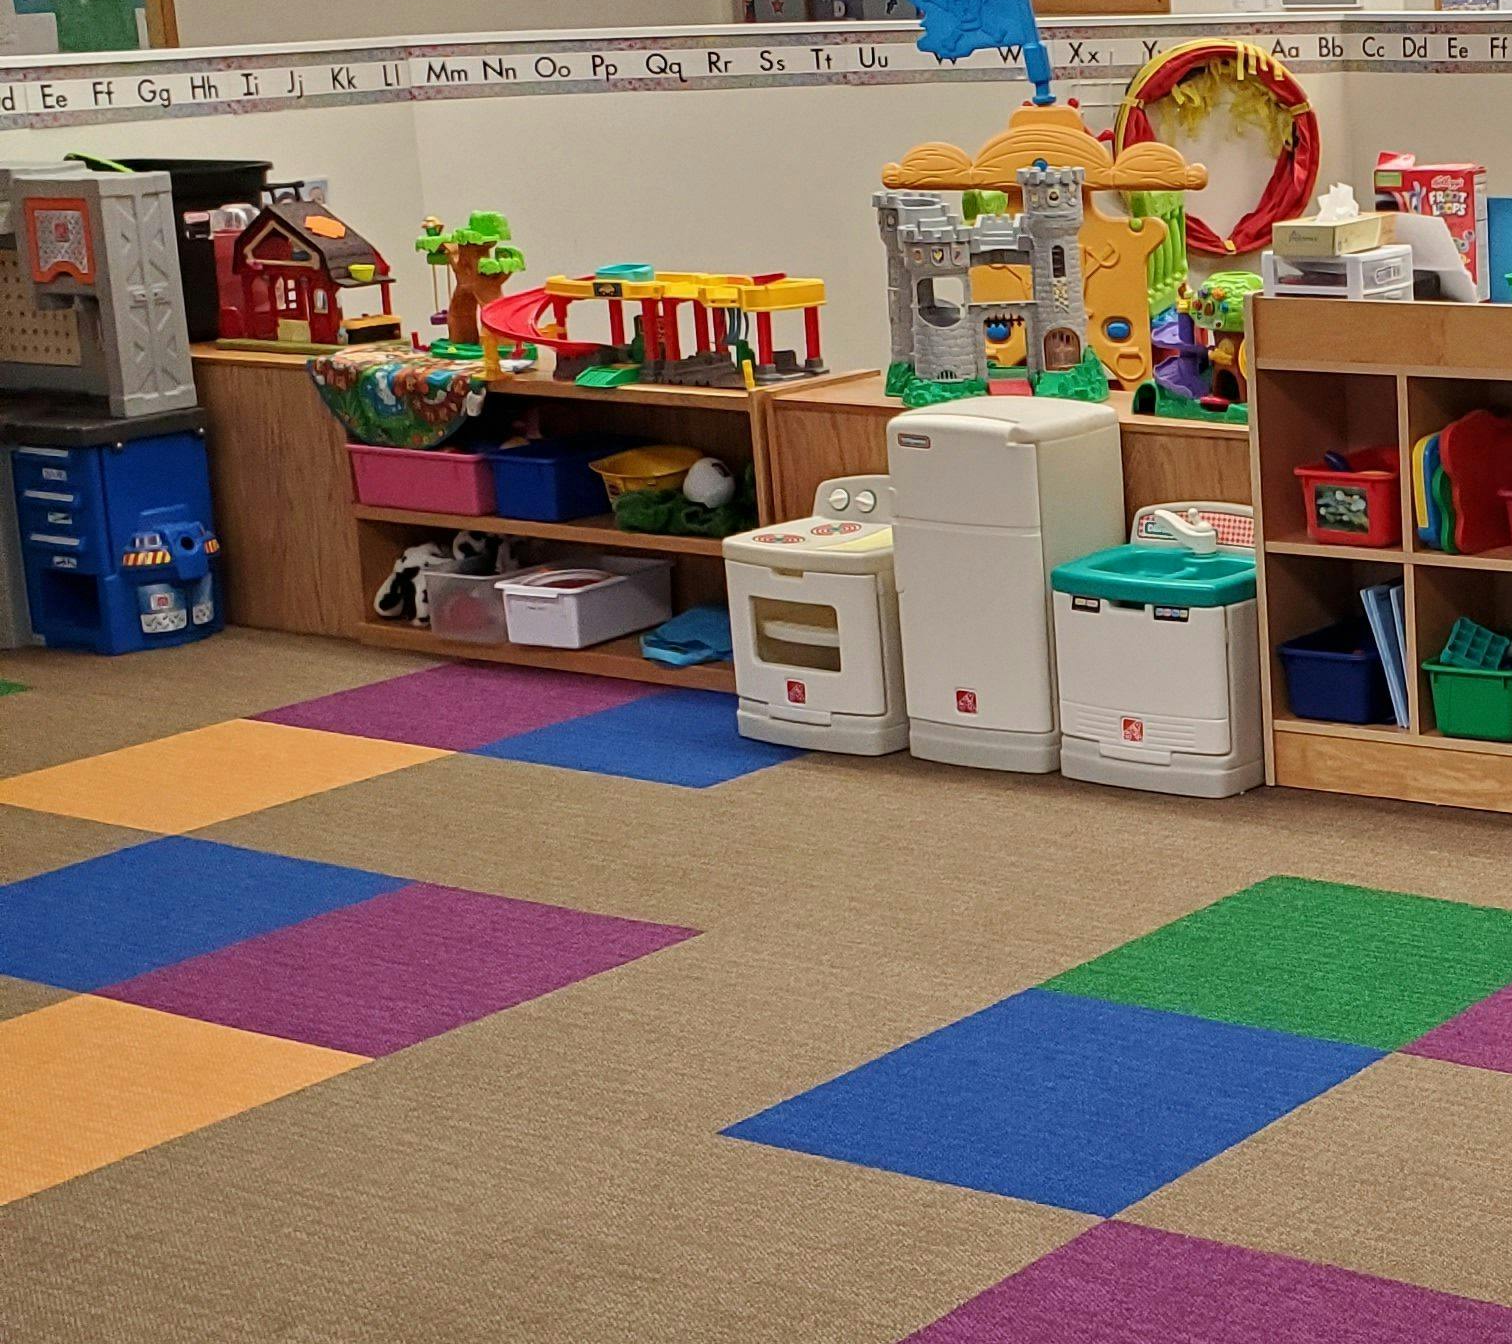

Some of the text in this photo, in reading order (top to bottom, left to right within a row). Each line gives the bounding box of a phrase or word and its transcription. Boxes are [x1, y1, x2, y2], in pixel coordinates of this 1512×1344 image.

[1271, 38, 1300, 58] Aa
[1318, 36, 1344, 58] Bb
[1362, 36, 1385, 58] Cc
[1402, 36, 1428, 59] Dd
[1447, 36, 1469, 59] Ee
[1490, 36, 1508, 59] Ff
[1, 86, 15, 111] d
[41, 84, 68, 109] Ee
[92, 81, 114, 106] Ff
[137, 79, 171, 109] Gg
[190, 76, 219, 100] Hh
[241, 72, 260, 97] Ii
[287, 70, 304, 100] Jj
[331, 66, 357, 91] Kk
[383, 63, 400, 88] Ll
[426, 61, 468, 83] Mm
[482, 58, 517, 81] Nn
[534, 56, 571, 78] Oo
[591, 54, 618, 81] Pp
[645, 53, 687, 82] Qq
[707, 51, 733, 74] Rr
[759, 49, 786, 72] Ss
[810, 48, 833, 71] Tt
[858, 46, 889, 70] Uu
[1068, 42, 1099, 64] Xx
[1428, 190, 1467, 204] FROOT
[1431, 203, 1467, 217] LOOPS
